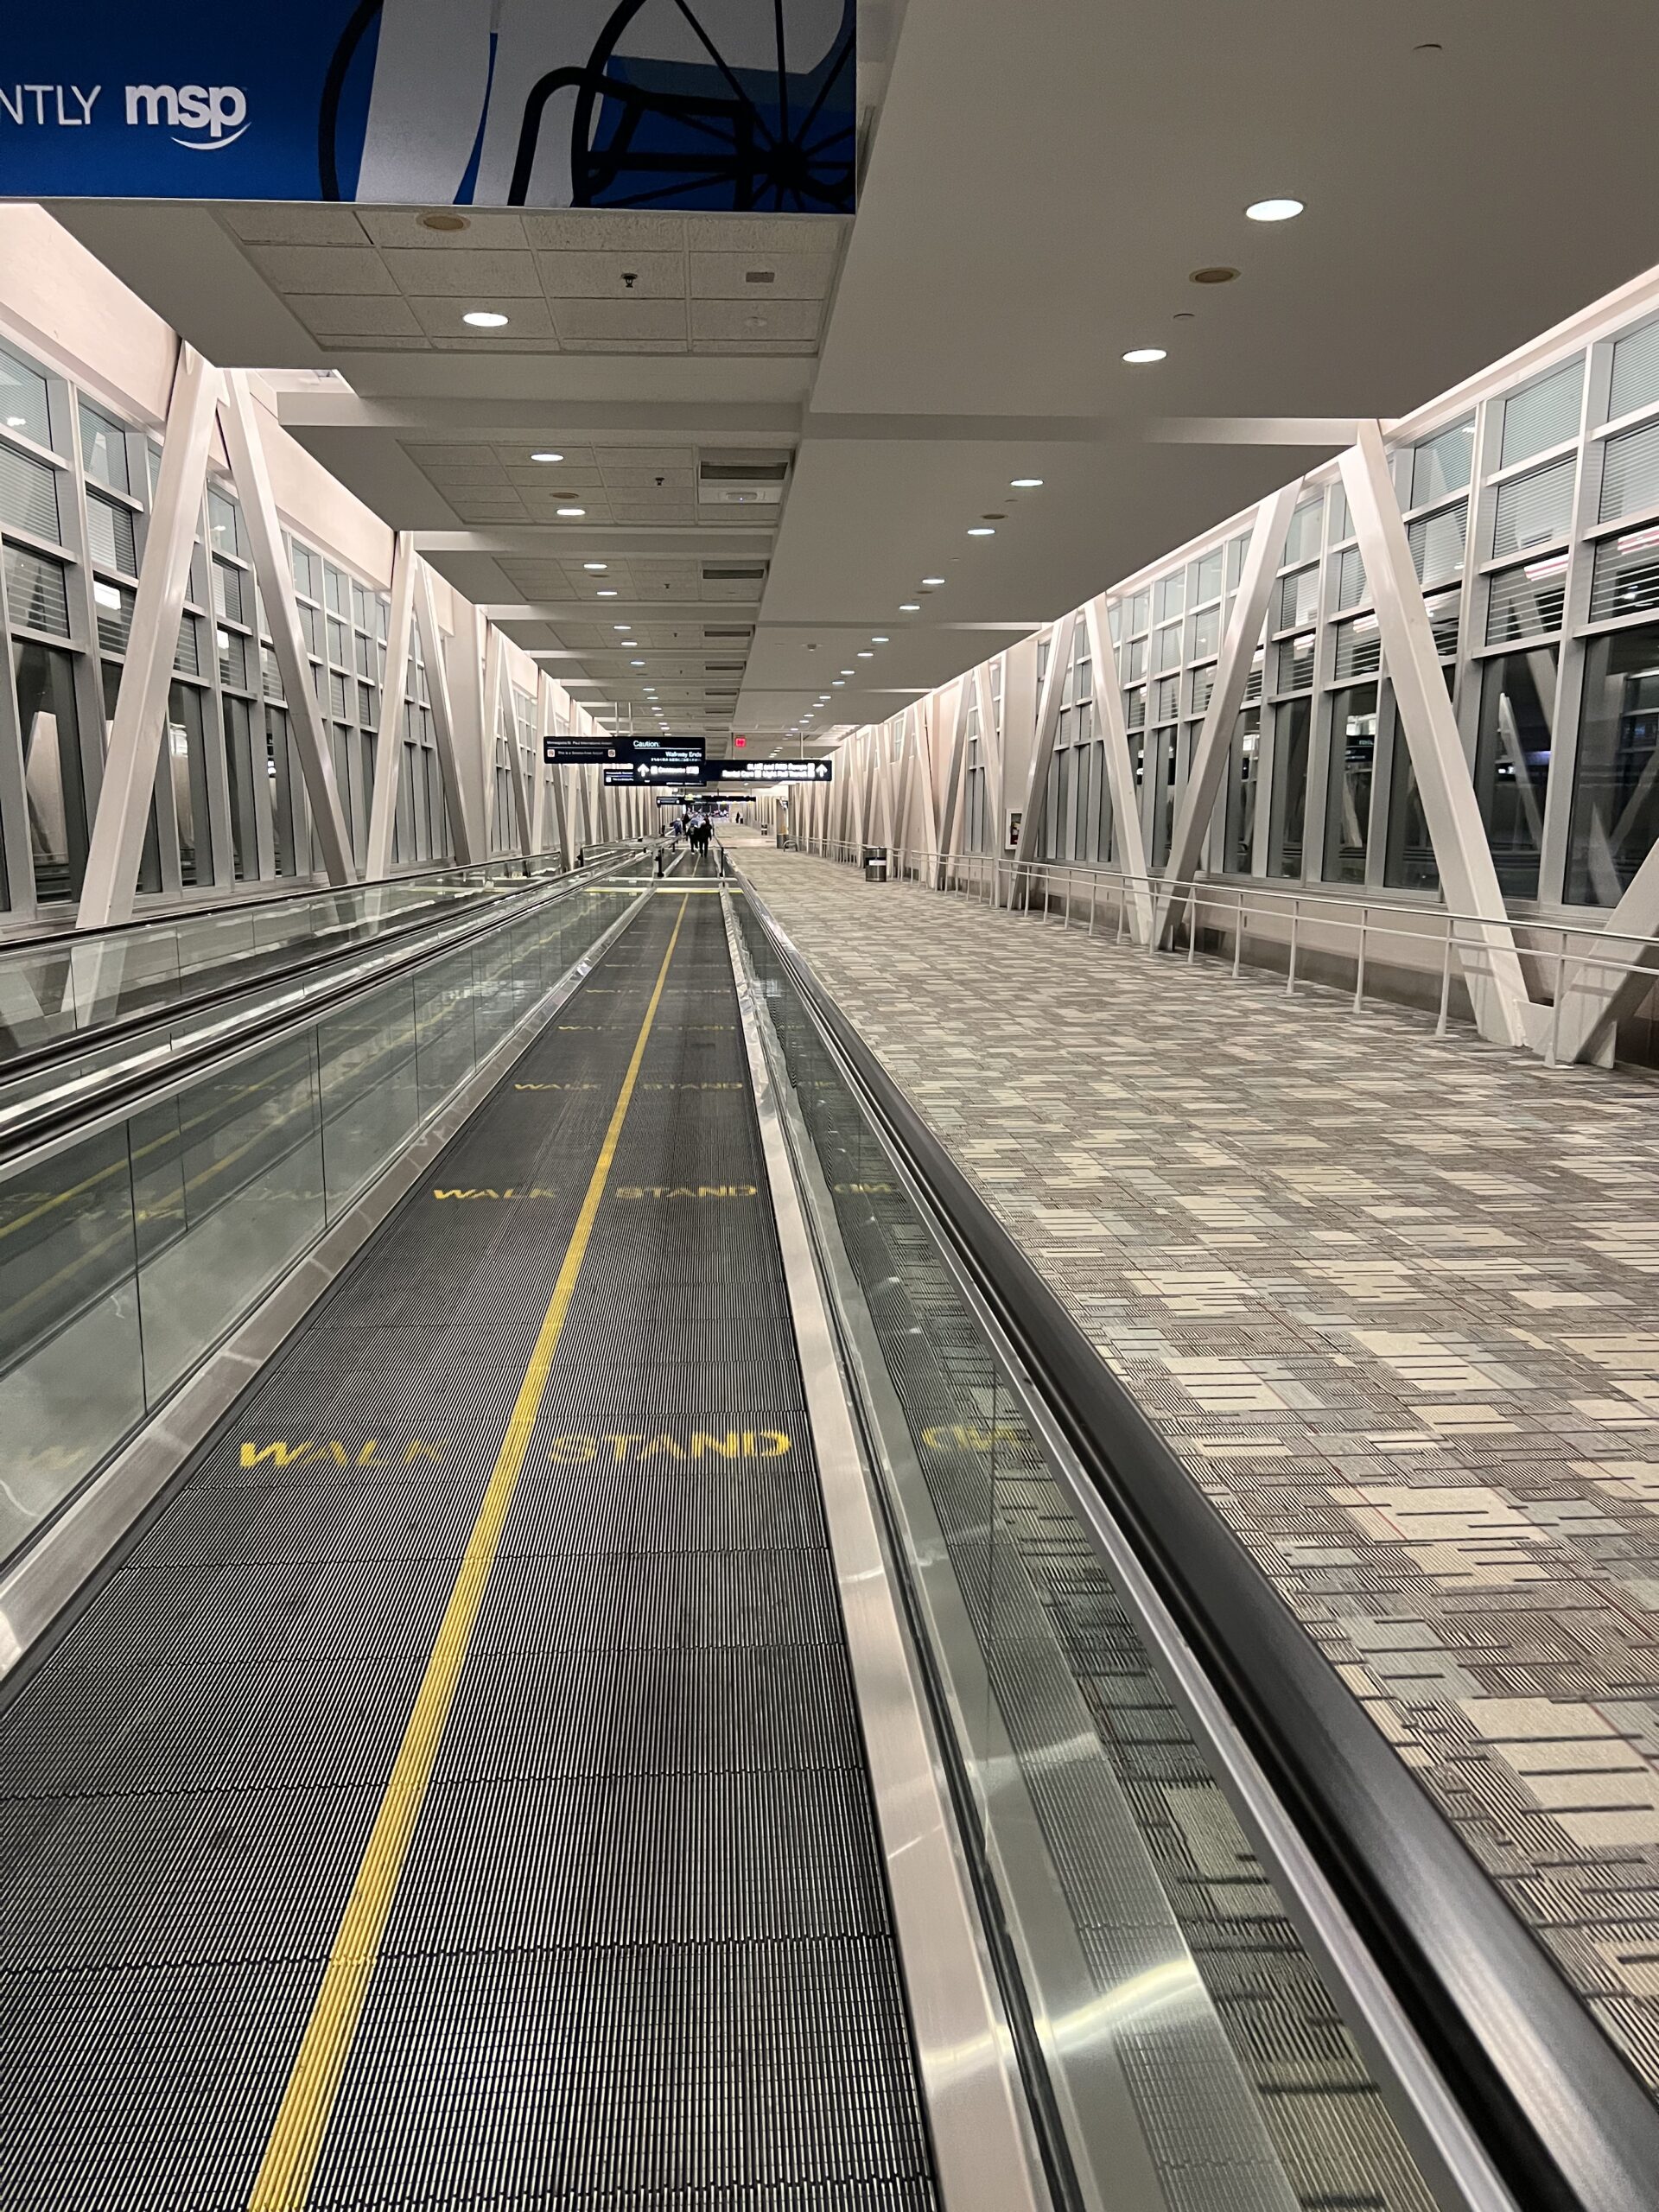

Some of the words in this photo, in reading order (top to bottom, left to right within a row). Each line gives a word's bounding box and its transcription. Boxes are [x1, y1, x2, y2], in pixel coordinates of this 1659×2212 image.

[124, 85, 247, 137] msp
[433, 1188, 558, 1199] WALK
[615, 1185, 759, 1199] STAND
[550, 1428, 793, 1464] STAND
